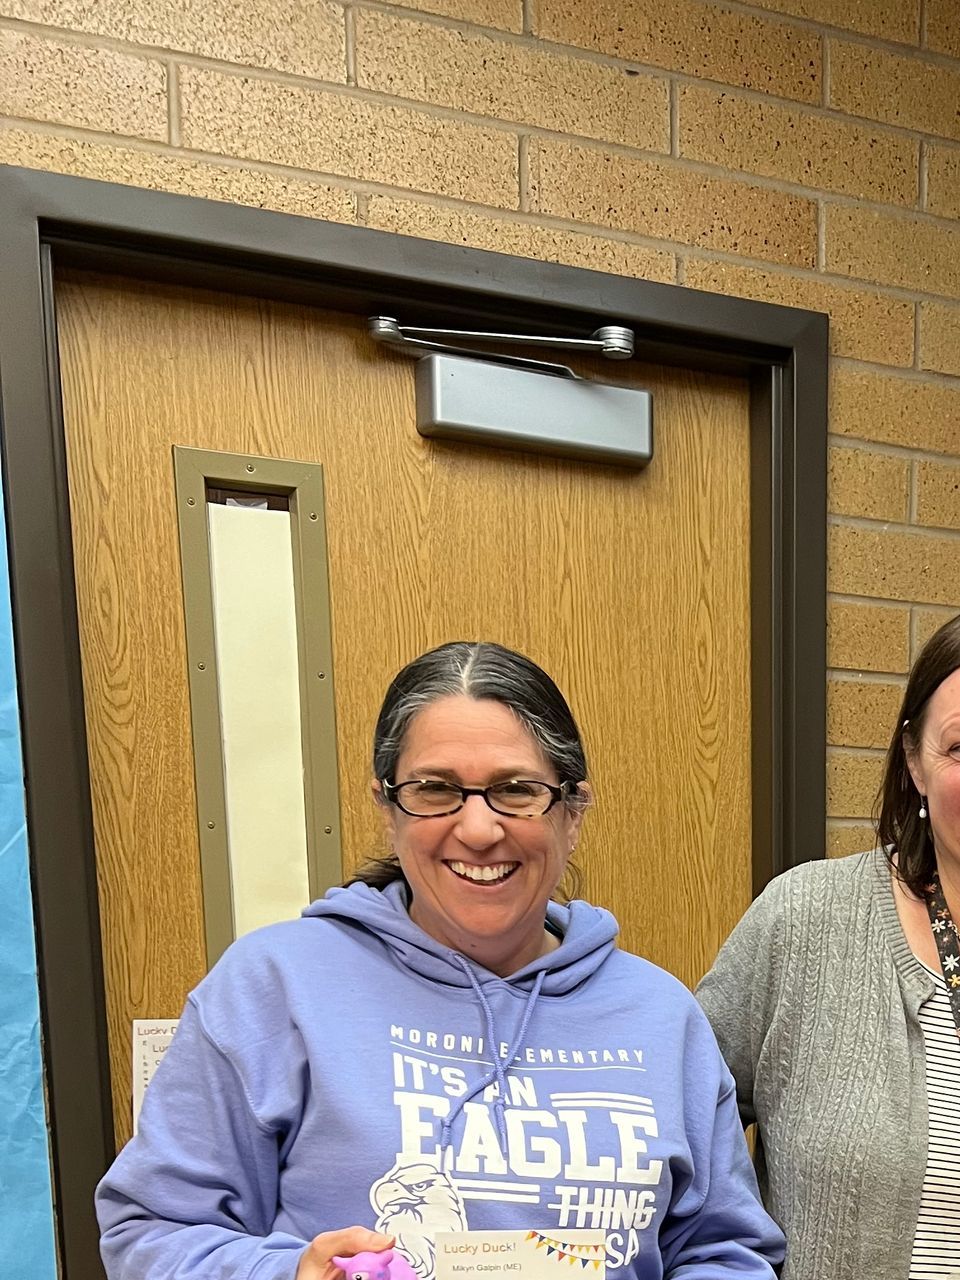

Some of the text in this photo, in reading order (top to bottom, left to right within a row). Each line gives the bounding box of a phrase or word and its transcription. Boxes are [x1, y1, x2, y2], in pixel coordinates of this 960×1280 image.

[390, 1024, 644, 1064] MORONI EEMENTARY
[392, 1052, 539, 1108] IT'S AN
[393, 1091, 664, 1185] EAGLE
[554, 1185, 657, 1231] THING
[444, 1242, 516, 1255] Lucky Duck!
[503, 1263, 522, 1272] (ME)
